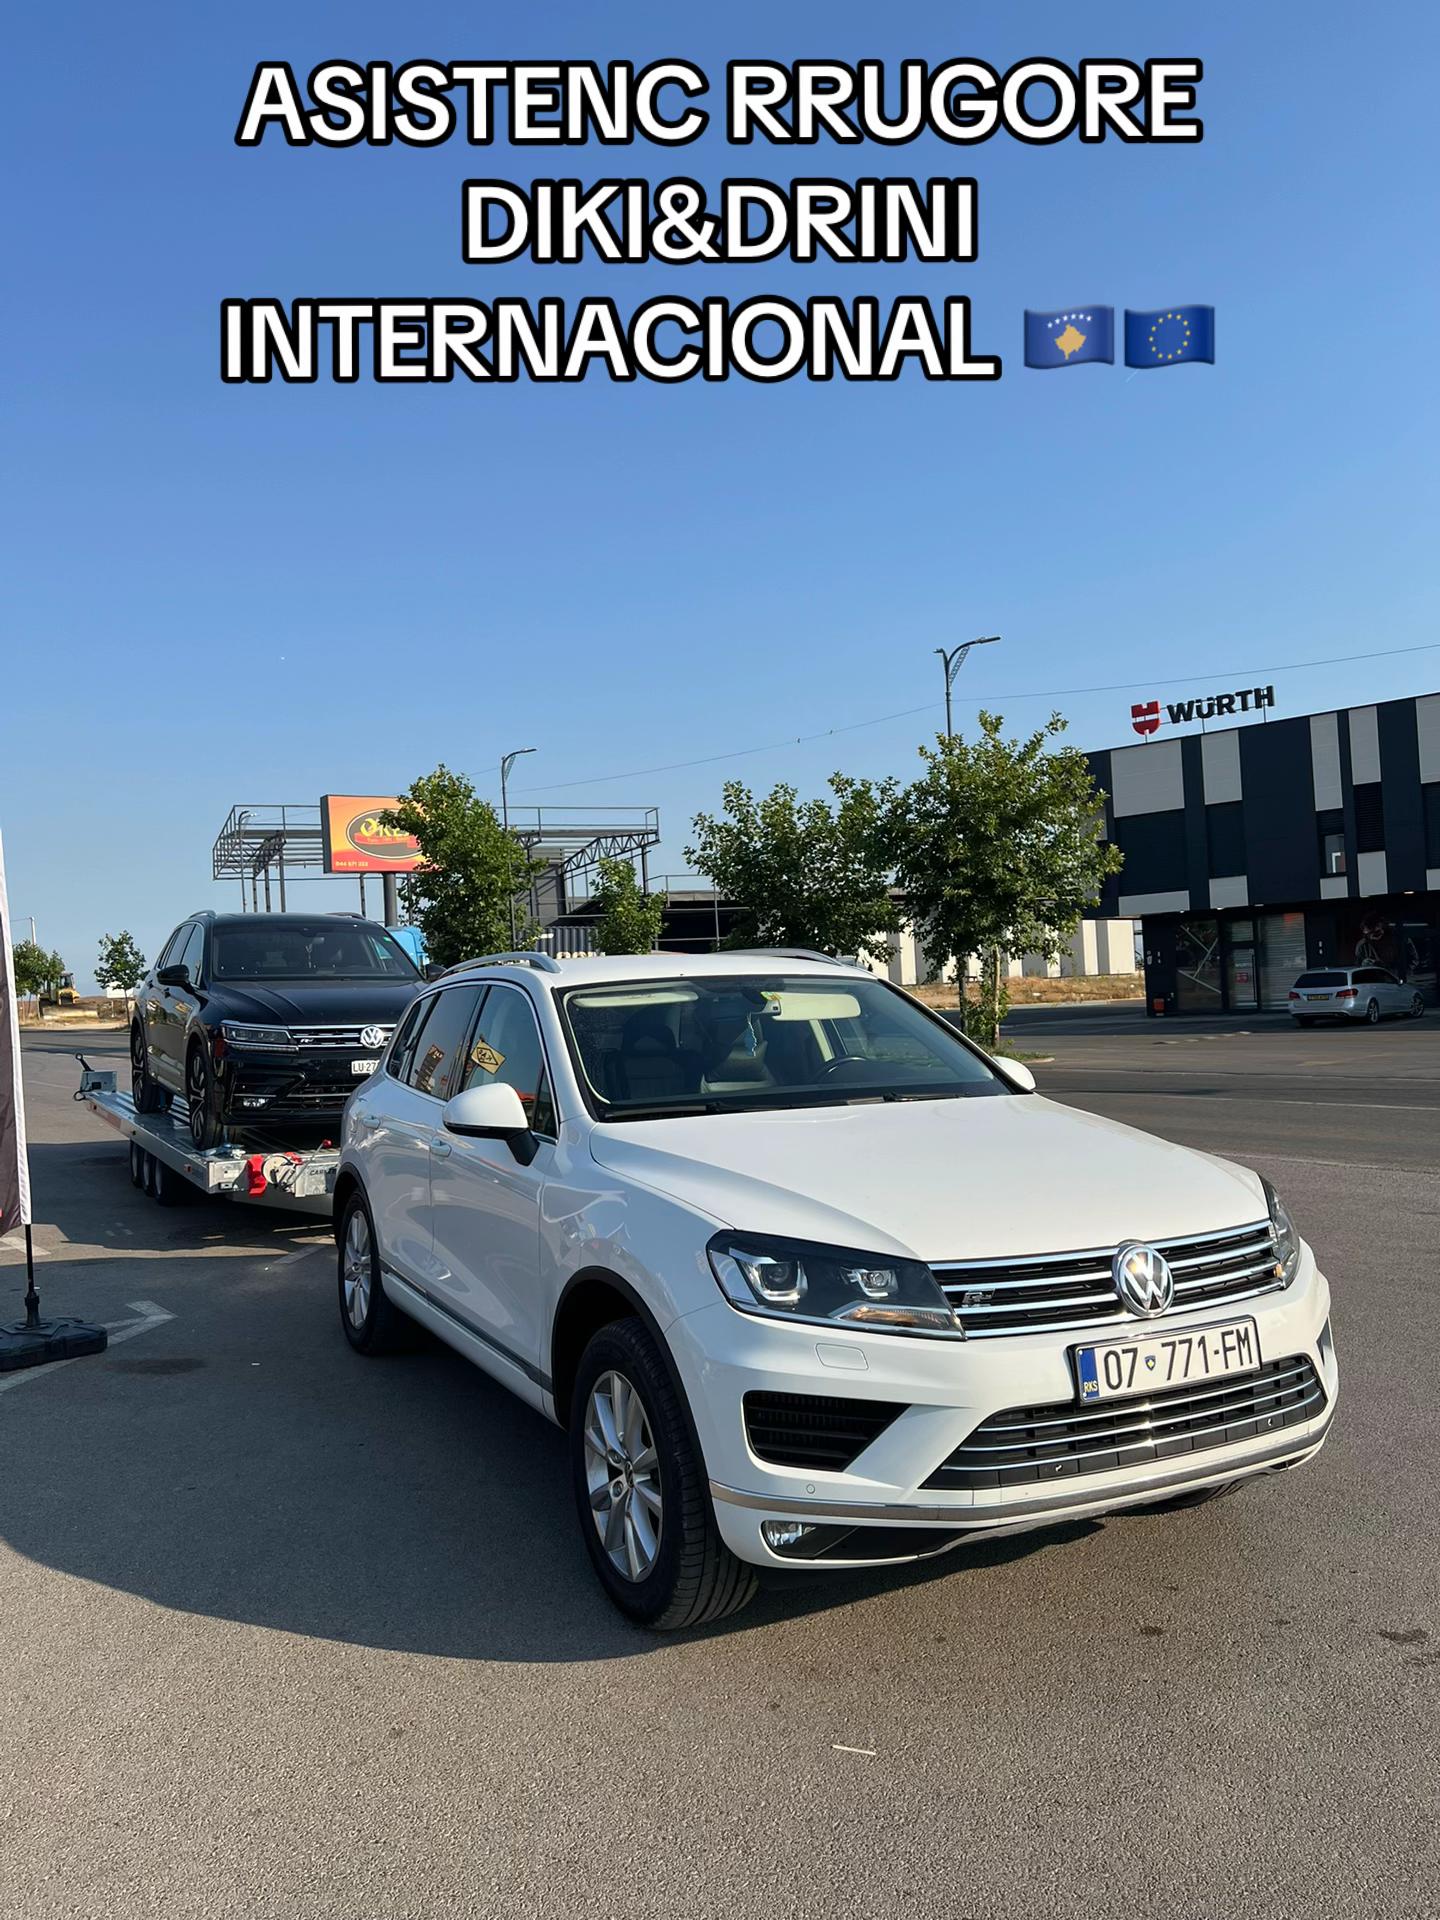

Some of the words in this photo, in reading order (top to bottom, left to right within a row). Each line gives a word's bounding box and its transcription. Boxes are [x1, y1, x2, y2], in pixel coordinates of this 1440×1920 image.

[1166, 685, 1275, 724] WÜRTH
[1103, 1347, 1139, 1390] 07
[1161, 1327, 1253, 1381] 771-FM
[1083, 1380, 1098, 1392] RKS
